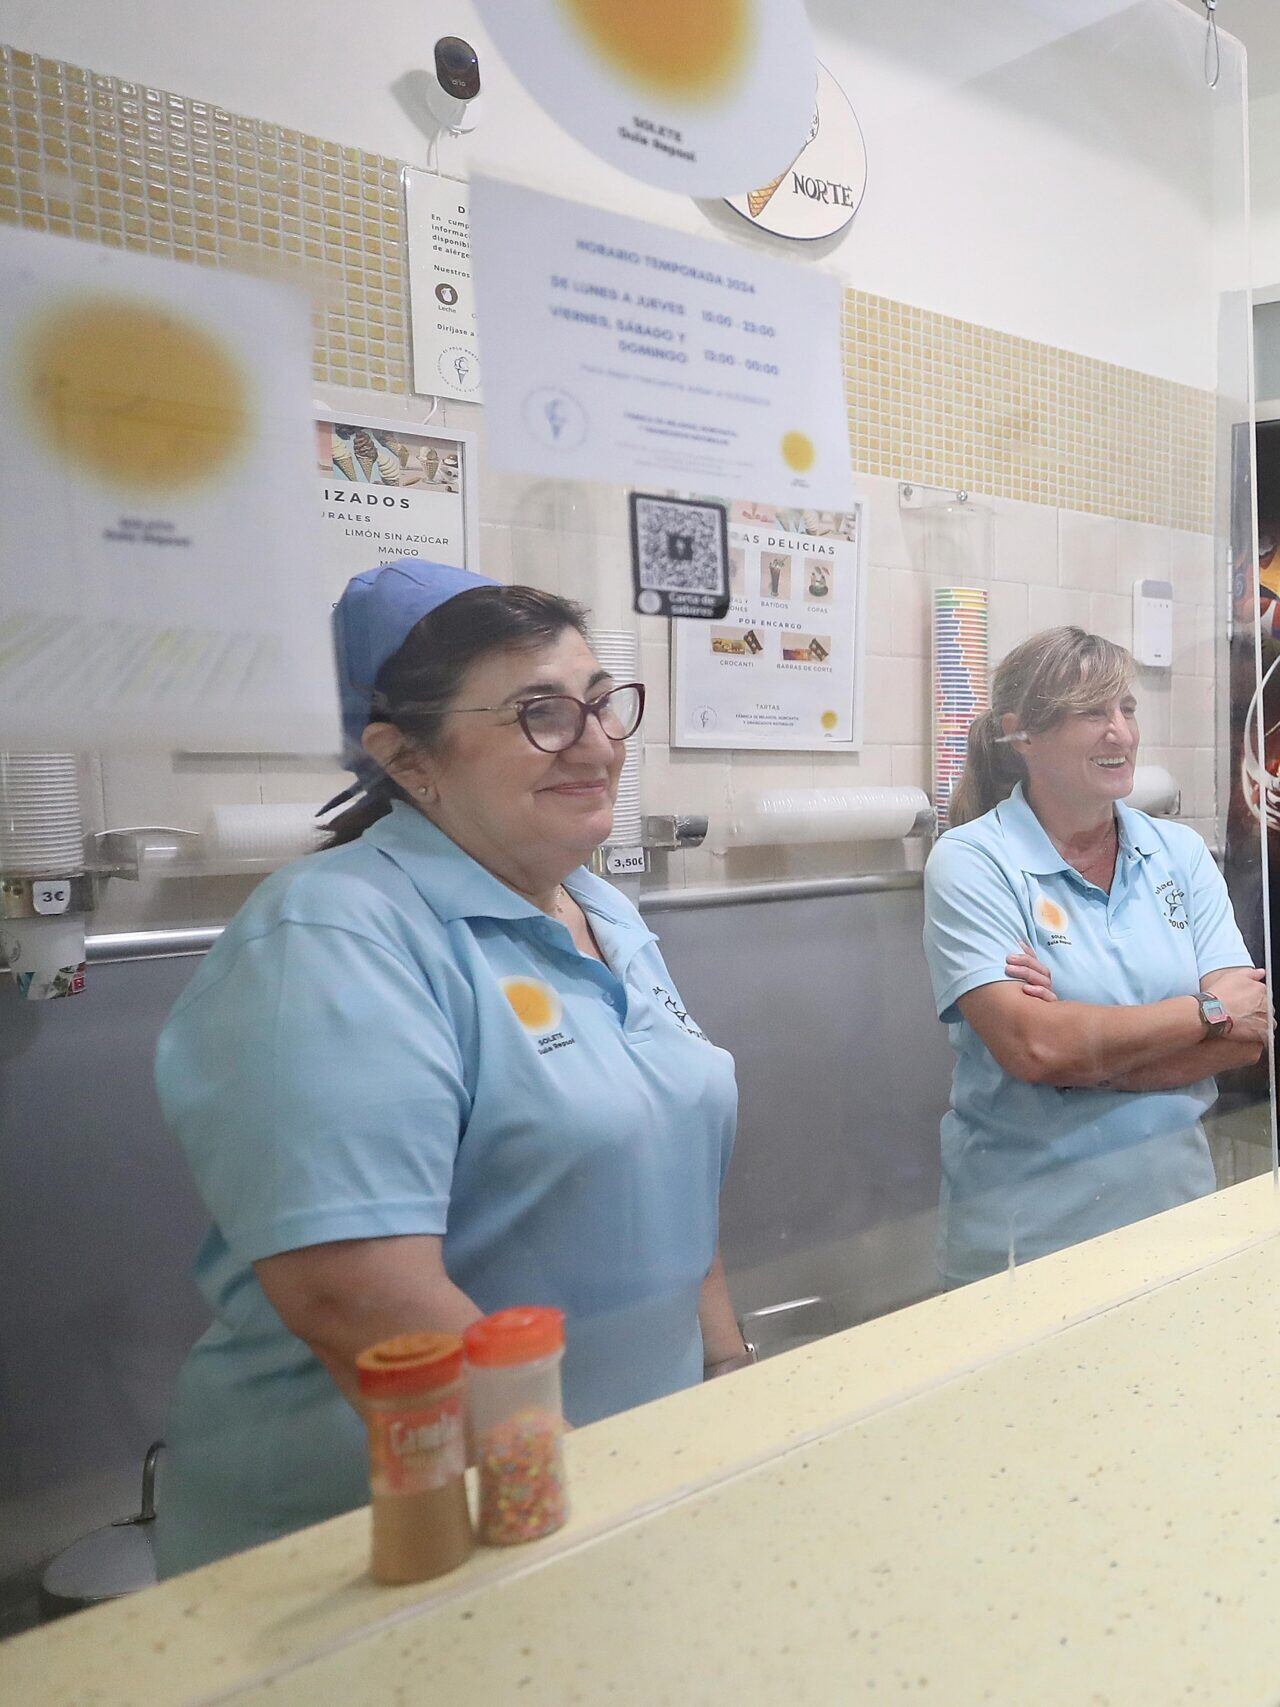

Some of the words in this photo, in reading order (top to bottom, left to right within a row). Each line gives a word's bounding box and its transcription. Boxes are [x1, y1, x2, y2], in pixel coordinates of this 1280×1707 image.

[791, 172, 855, 209] NORTE
[431, 224, 471, 239] informac
[433, 264, 470, 279] Nuestros
[345, 528, 381, 539] LIMÓN
[384, 532, 402, 541] SIN
[406, 534, 449, 546] AZÚCAR
[378, 546, 419, 557] MANGO
[767, 537, 836, 556] DELICIAS
[760, 601, 789, 610] BATIDOS
[807, 606, 829, 615] COPAS
[738, 617, 757, 625] POR
[760, 620, 802, 630] ENCARGO
[719, 659, 754, 668] CROCANTI
[776, 663, 802, 671] BARRAS
[756, 703, 781, 711] TARTAS
[614, 857, 643, 868] 3,50€
[42, 891, 65, 903] 3€
